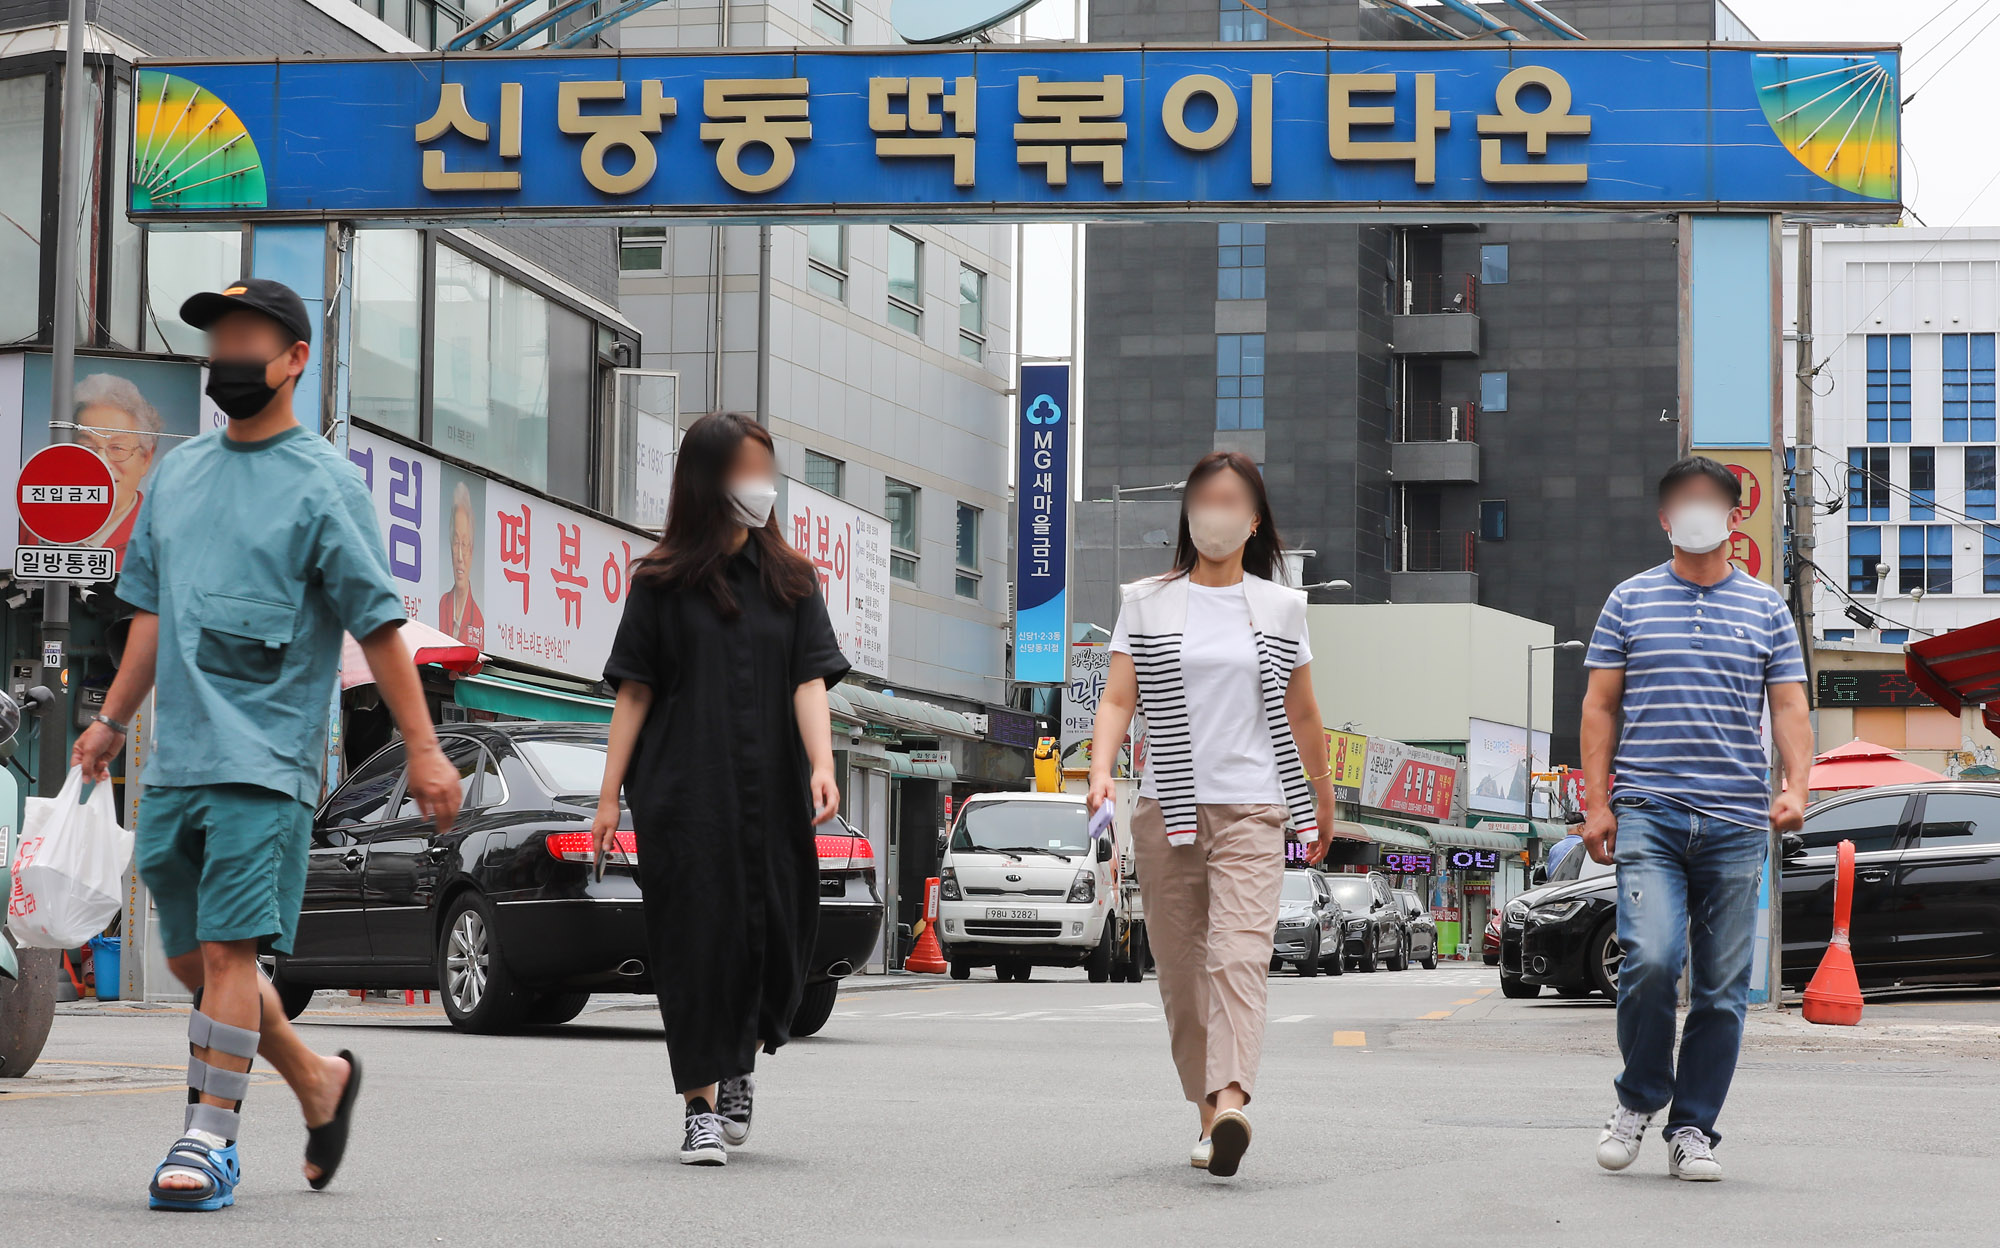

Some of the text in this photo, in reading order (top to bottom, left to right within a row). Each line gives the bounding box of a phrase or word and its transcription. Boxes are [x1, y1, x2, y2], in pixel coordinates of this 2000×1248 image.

[415, 65, 1592, 195] 신당동 떡볶이 타운
[31, 486, 102, 502] 진입금지
[1031, 430, 1053, 577] MG새마을금고
[21, 552, 107, 576] 일방통행
[517, 628, 542, 656] 며느리도
[1019, 643, 1059, 653] 신당동지점
[46, 655, 58, 665] 10
[1403, 765, 1436, 803] 우리집
[1011, 911, 1033, 919] 3282
